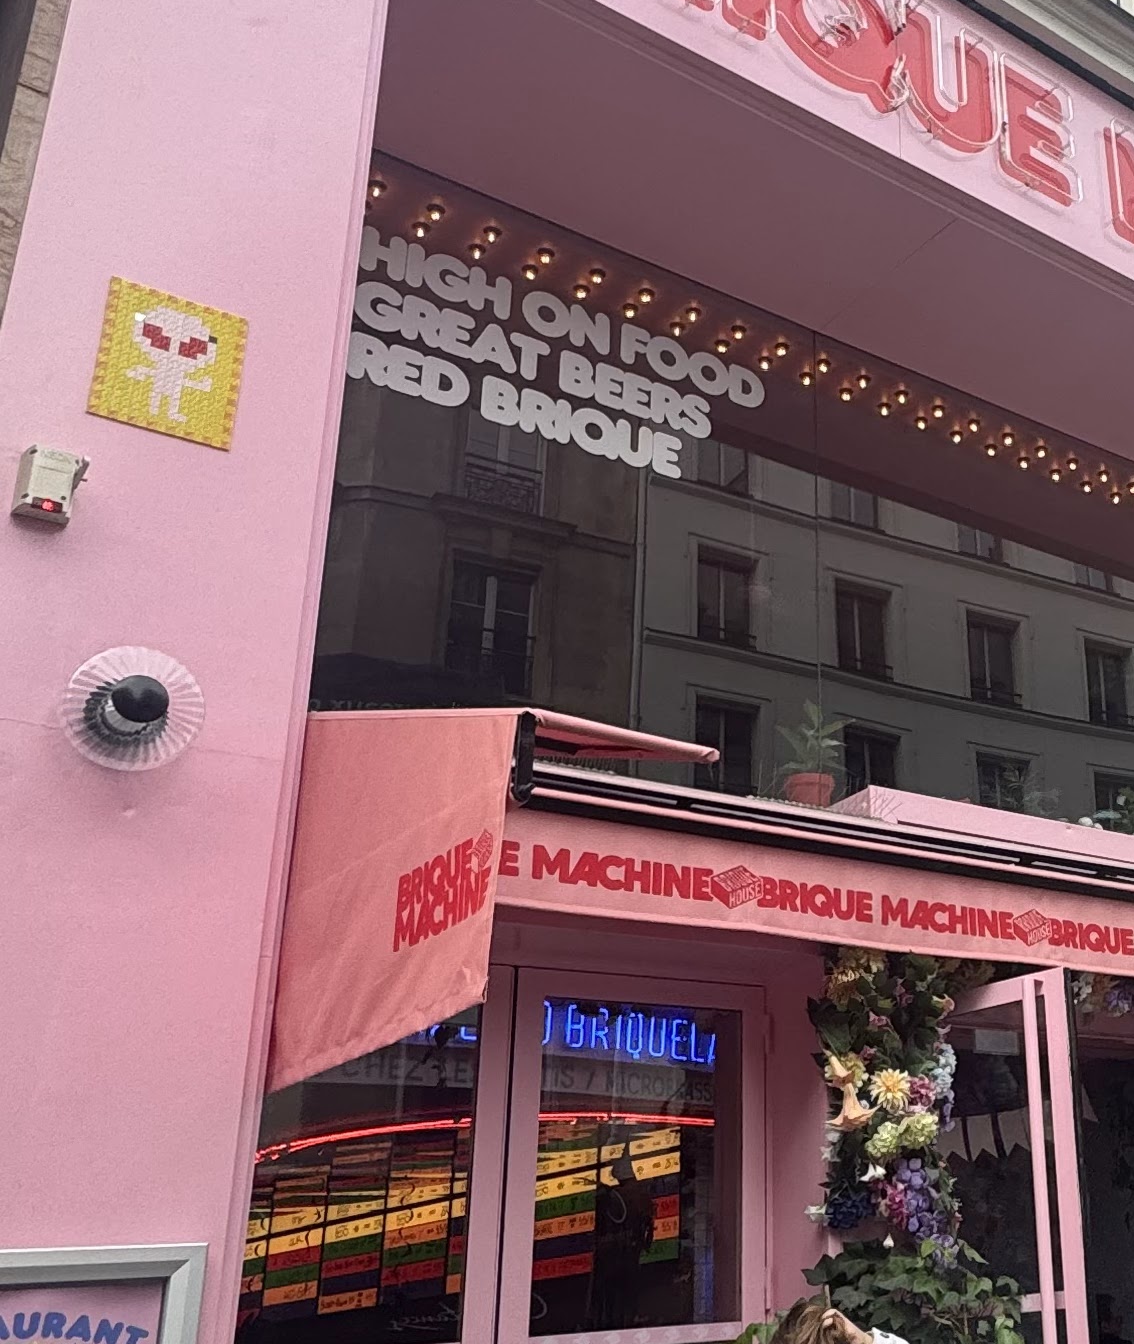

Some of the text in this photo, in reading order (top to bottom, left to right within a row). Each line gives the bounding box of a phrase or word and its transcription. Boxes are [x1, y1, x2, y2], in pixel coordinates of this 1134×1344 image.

[359, 226, 765, 408] HIGH ON FOOD
[354, 281, 711, 439] GREAT BEERS
[347, 331, 682, 479] RED BRIQUE
[393, 866, 491, 952] MACHINE
[398, 837, 473, 913] BRIQUE
[532, 845, 713, 902] MACHINE
[729, 881, 762, 907] HOUSE
[758, 876, 1014, 940] BRIQUE MACHINE
[1048, 918, 1134, 955] BRIQUE
